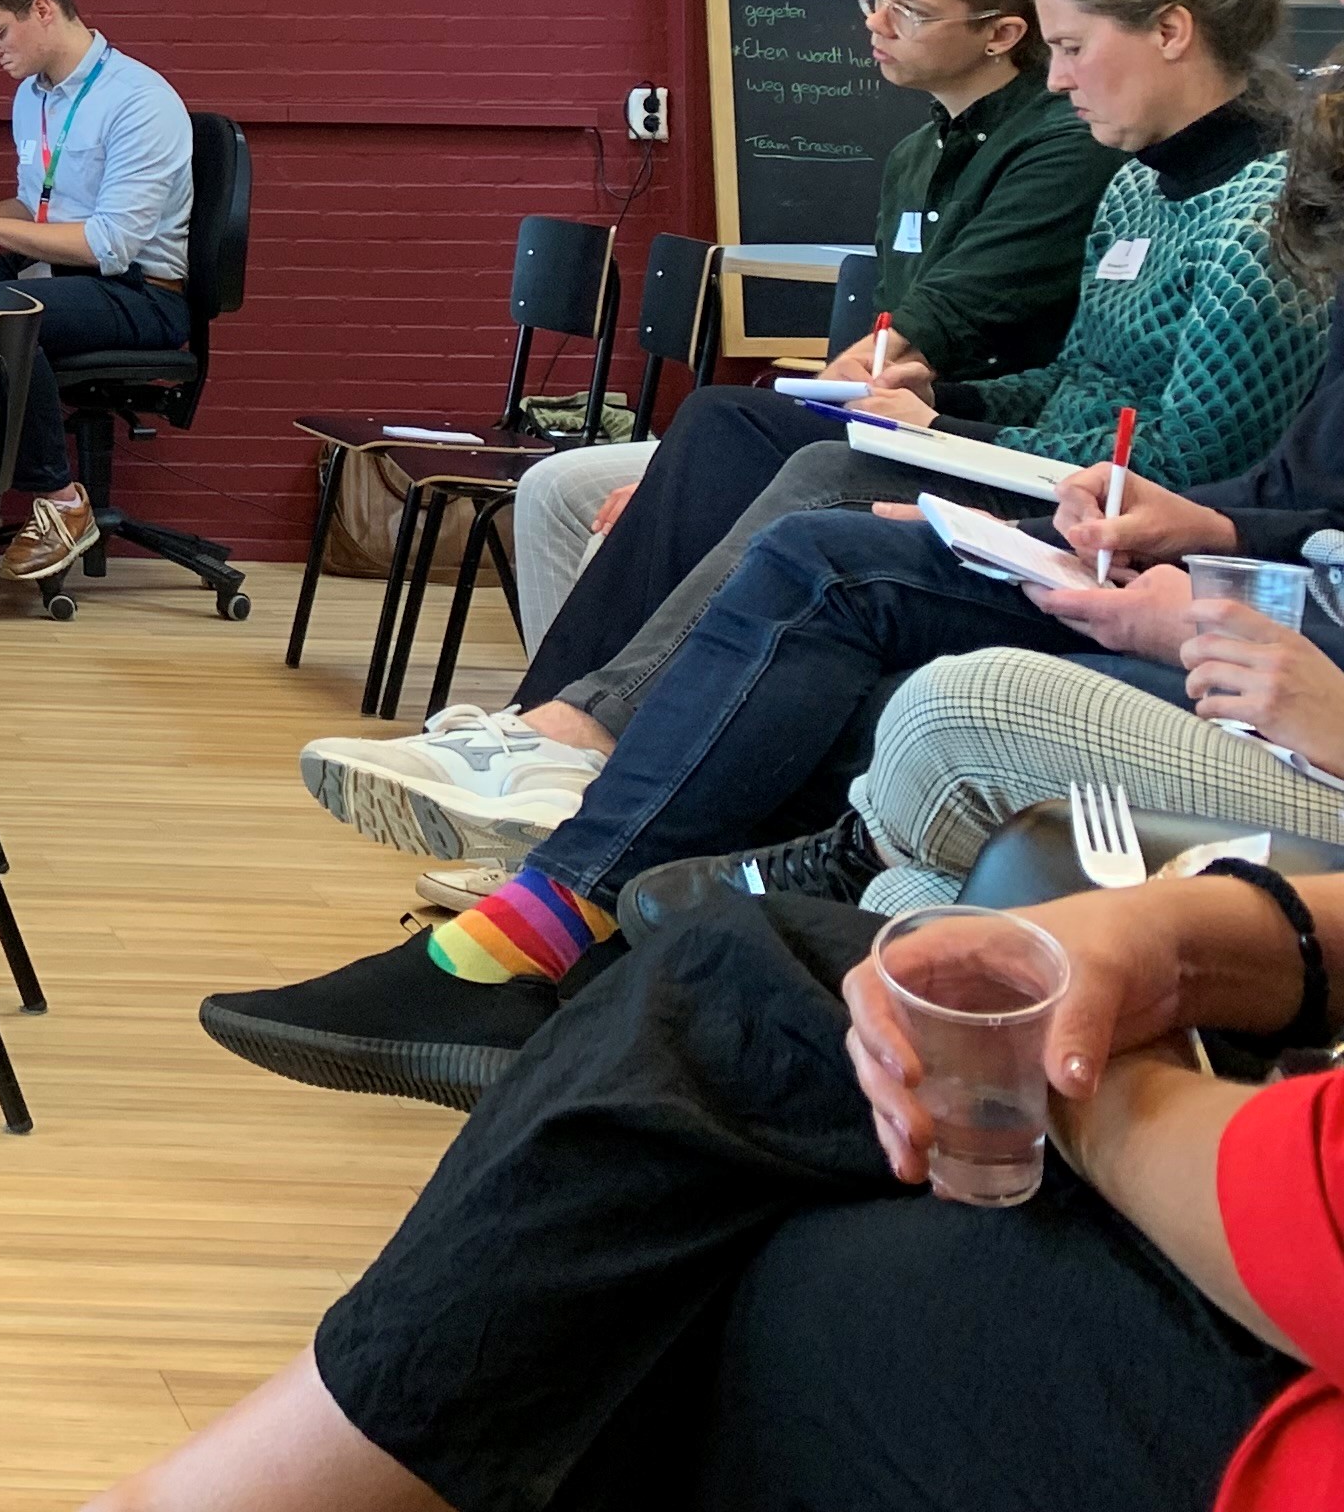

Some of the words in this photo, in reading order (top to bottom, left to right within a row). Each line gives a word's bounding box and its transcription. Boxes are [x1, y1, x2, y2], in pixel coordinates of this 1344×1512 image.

[745, 2, 807, 27] gegeten
[743, 38, 789, 61] Eten
[797, 47, 843, 64] wordt
[745, 135, 791, 150] Team
[791, 135, 864, 154] Brasserie
